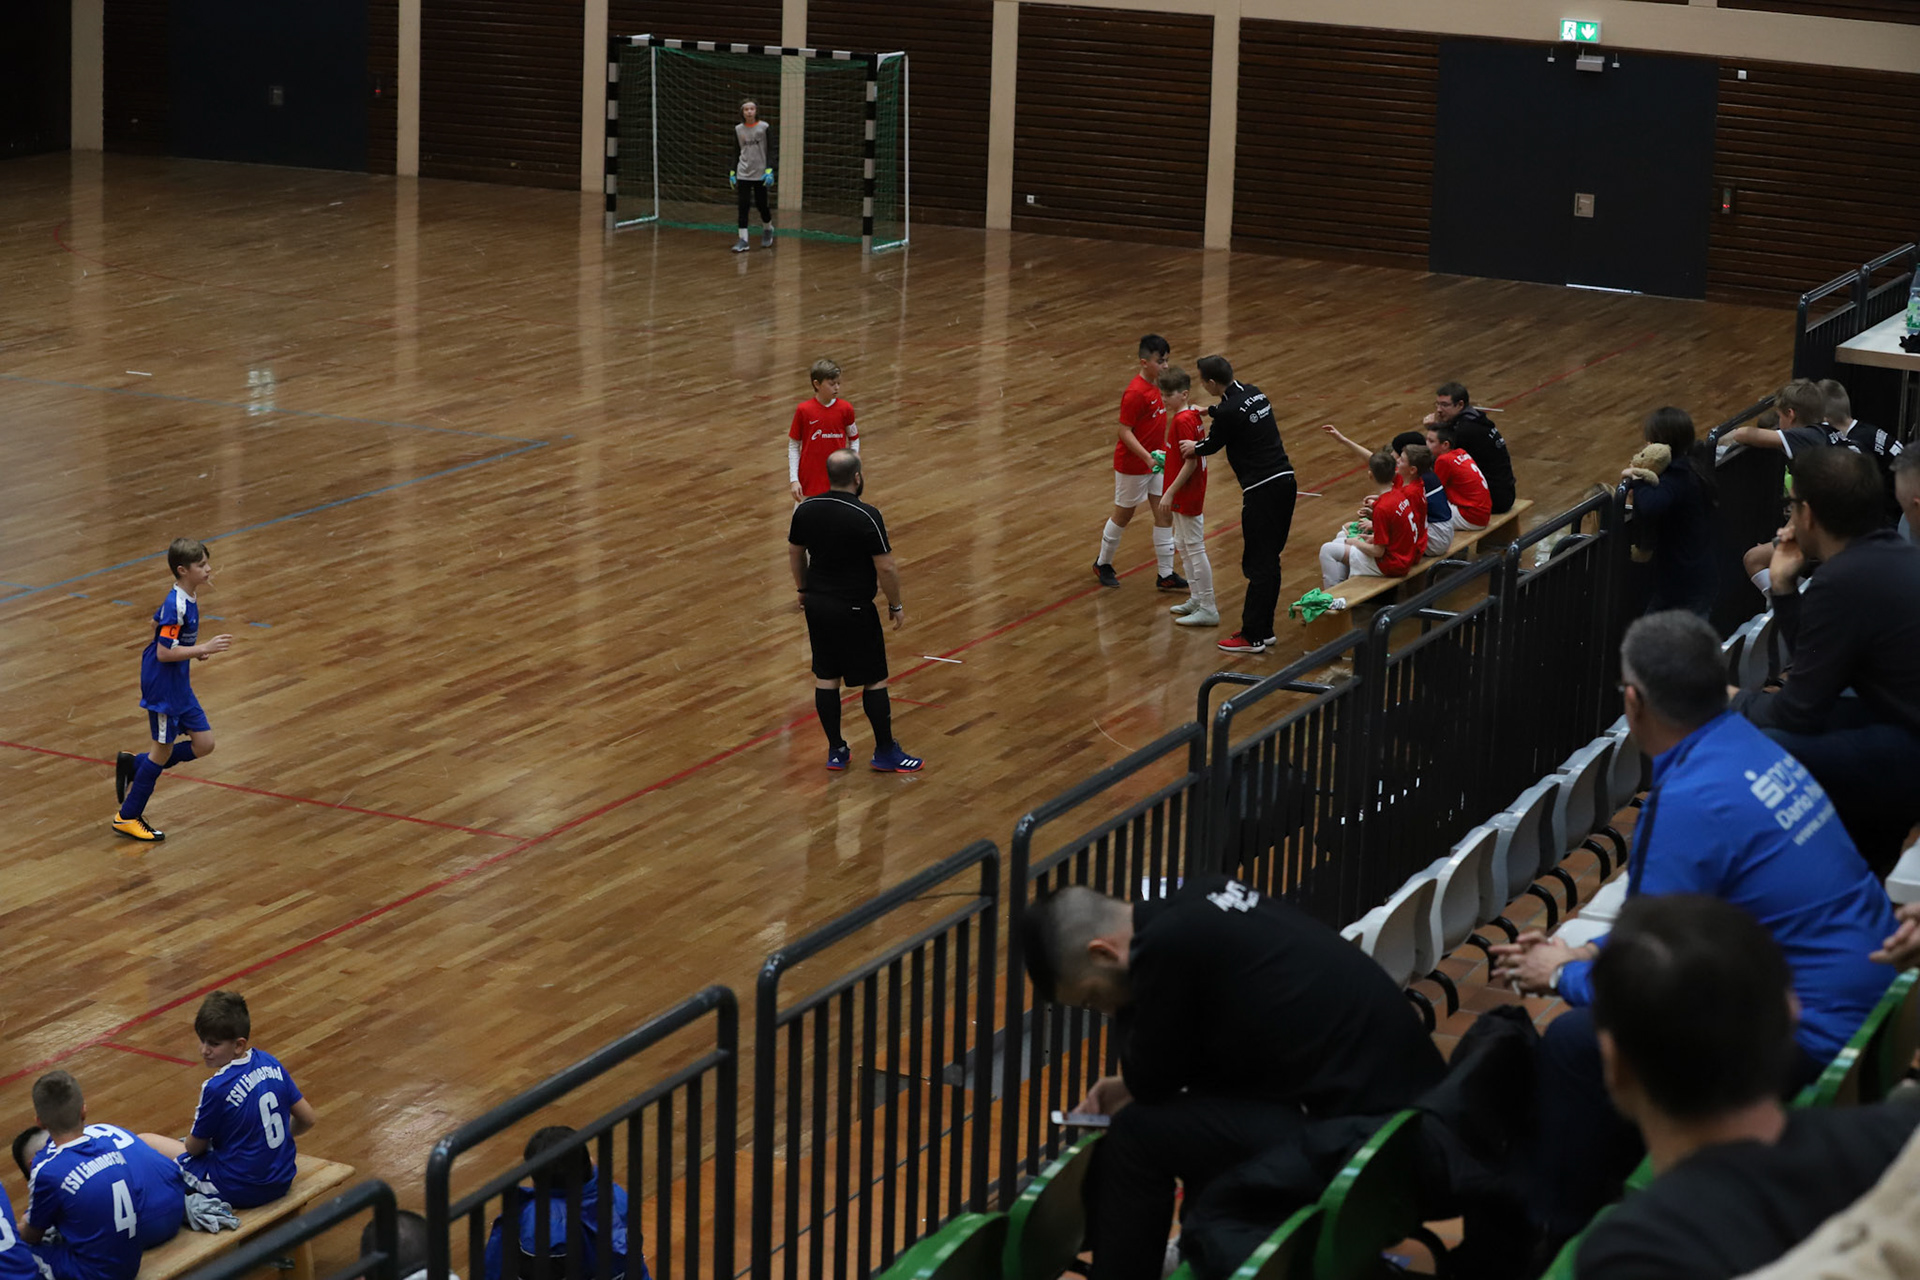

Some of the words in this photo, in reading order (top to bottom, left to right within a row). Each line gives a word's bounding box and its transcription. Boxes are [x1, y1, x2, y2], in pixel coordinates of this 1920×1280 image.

[169, 626, 178, 637] C
[225, 1083, 248, 1107] TSV
[259, 1091, 285, 1149] 6
[60, 1170, 85, 1195] TSV
[111, 1179, 138, 1239] 4
